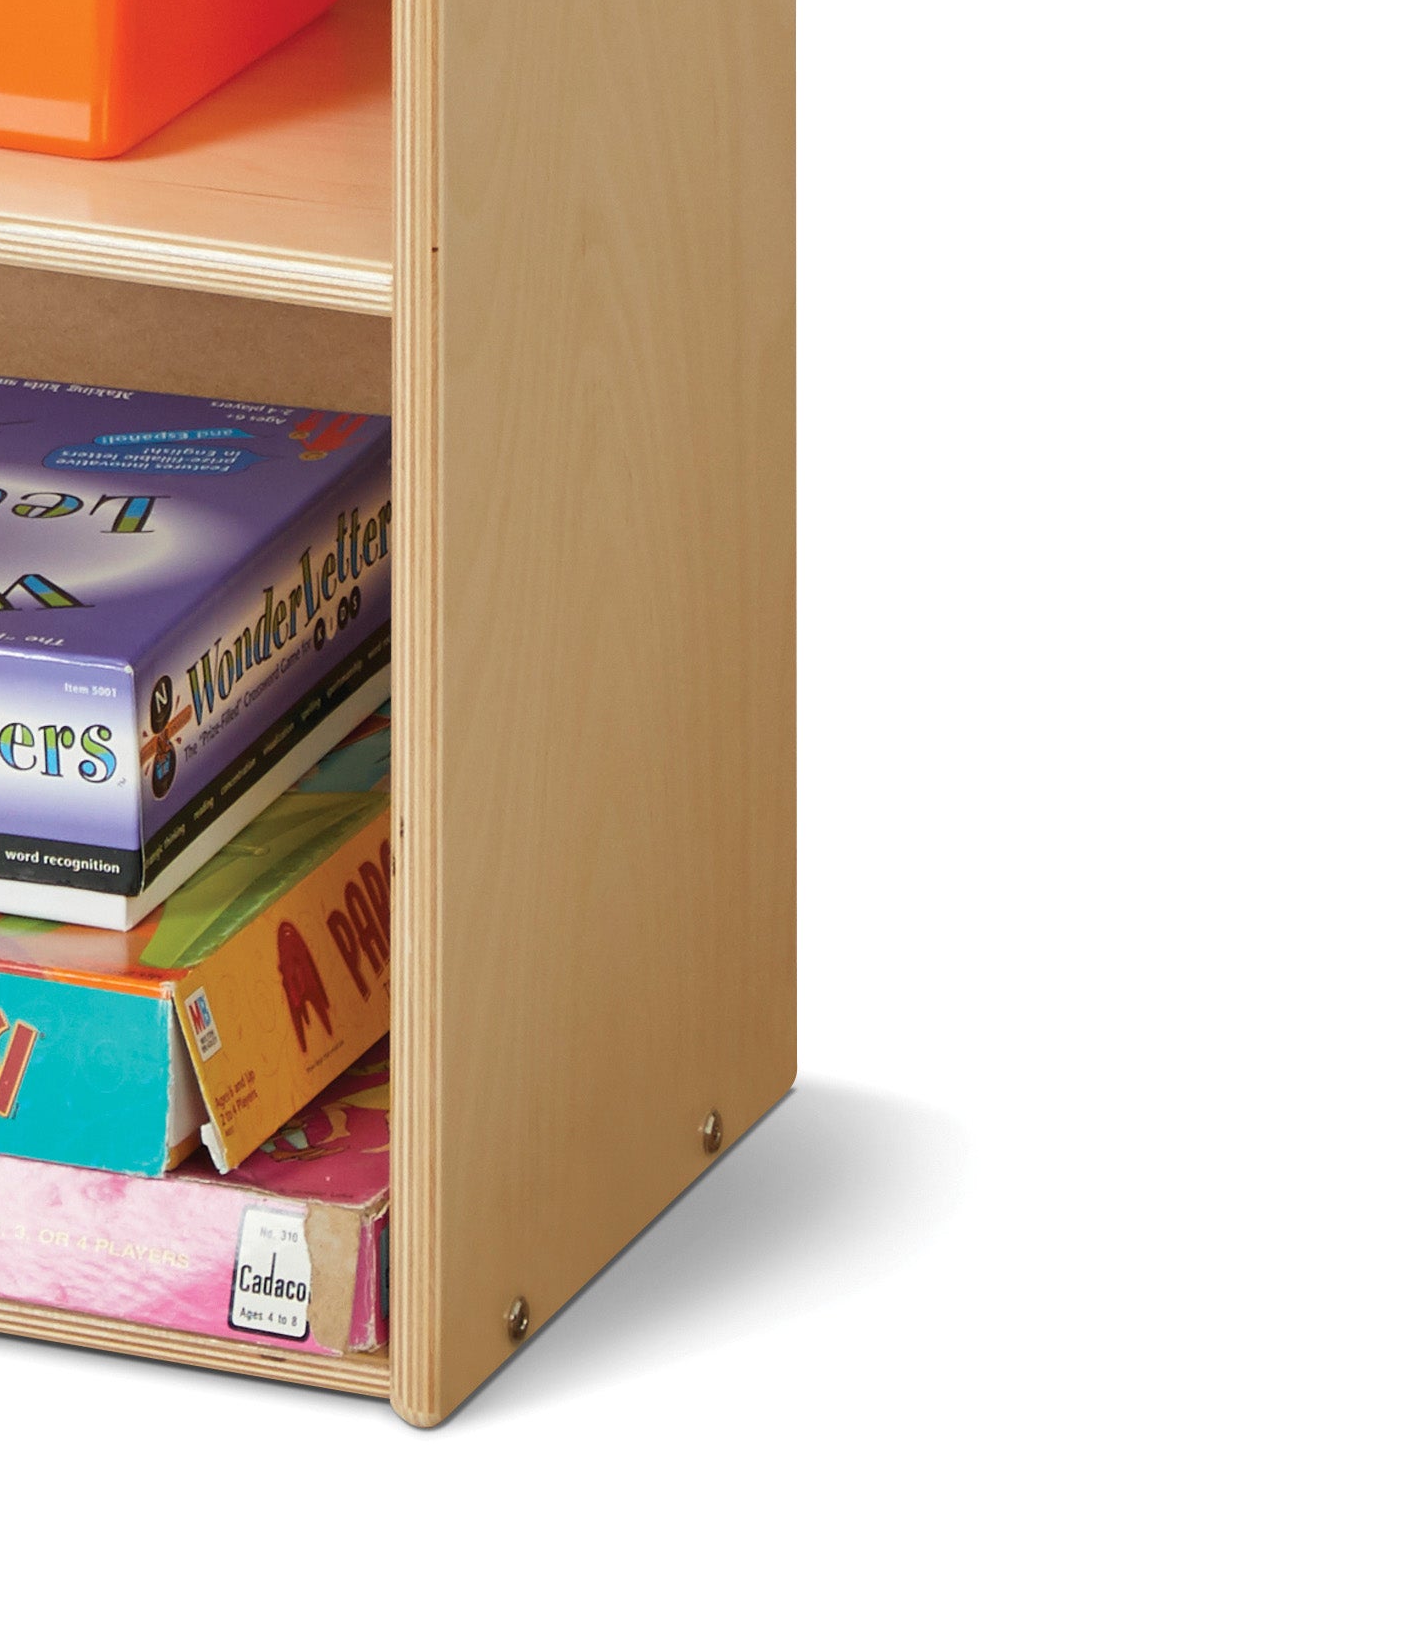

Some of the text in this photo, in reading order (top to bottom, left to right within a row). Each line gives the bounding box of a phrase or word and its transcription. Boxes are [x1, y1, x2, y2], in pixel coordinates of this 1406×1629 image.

[4, 849, 40, 864] word
[43, 853, 120, 874] recognition
[94, 1234, 190, 1270] PLAYERS
[238, 1252, 307, 1302] Cadaco
[239, 1306, 263, 1321] Ages
